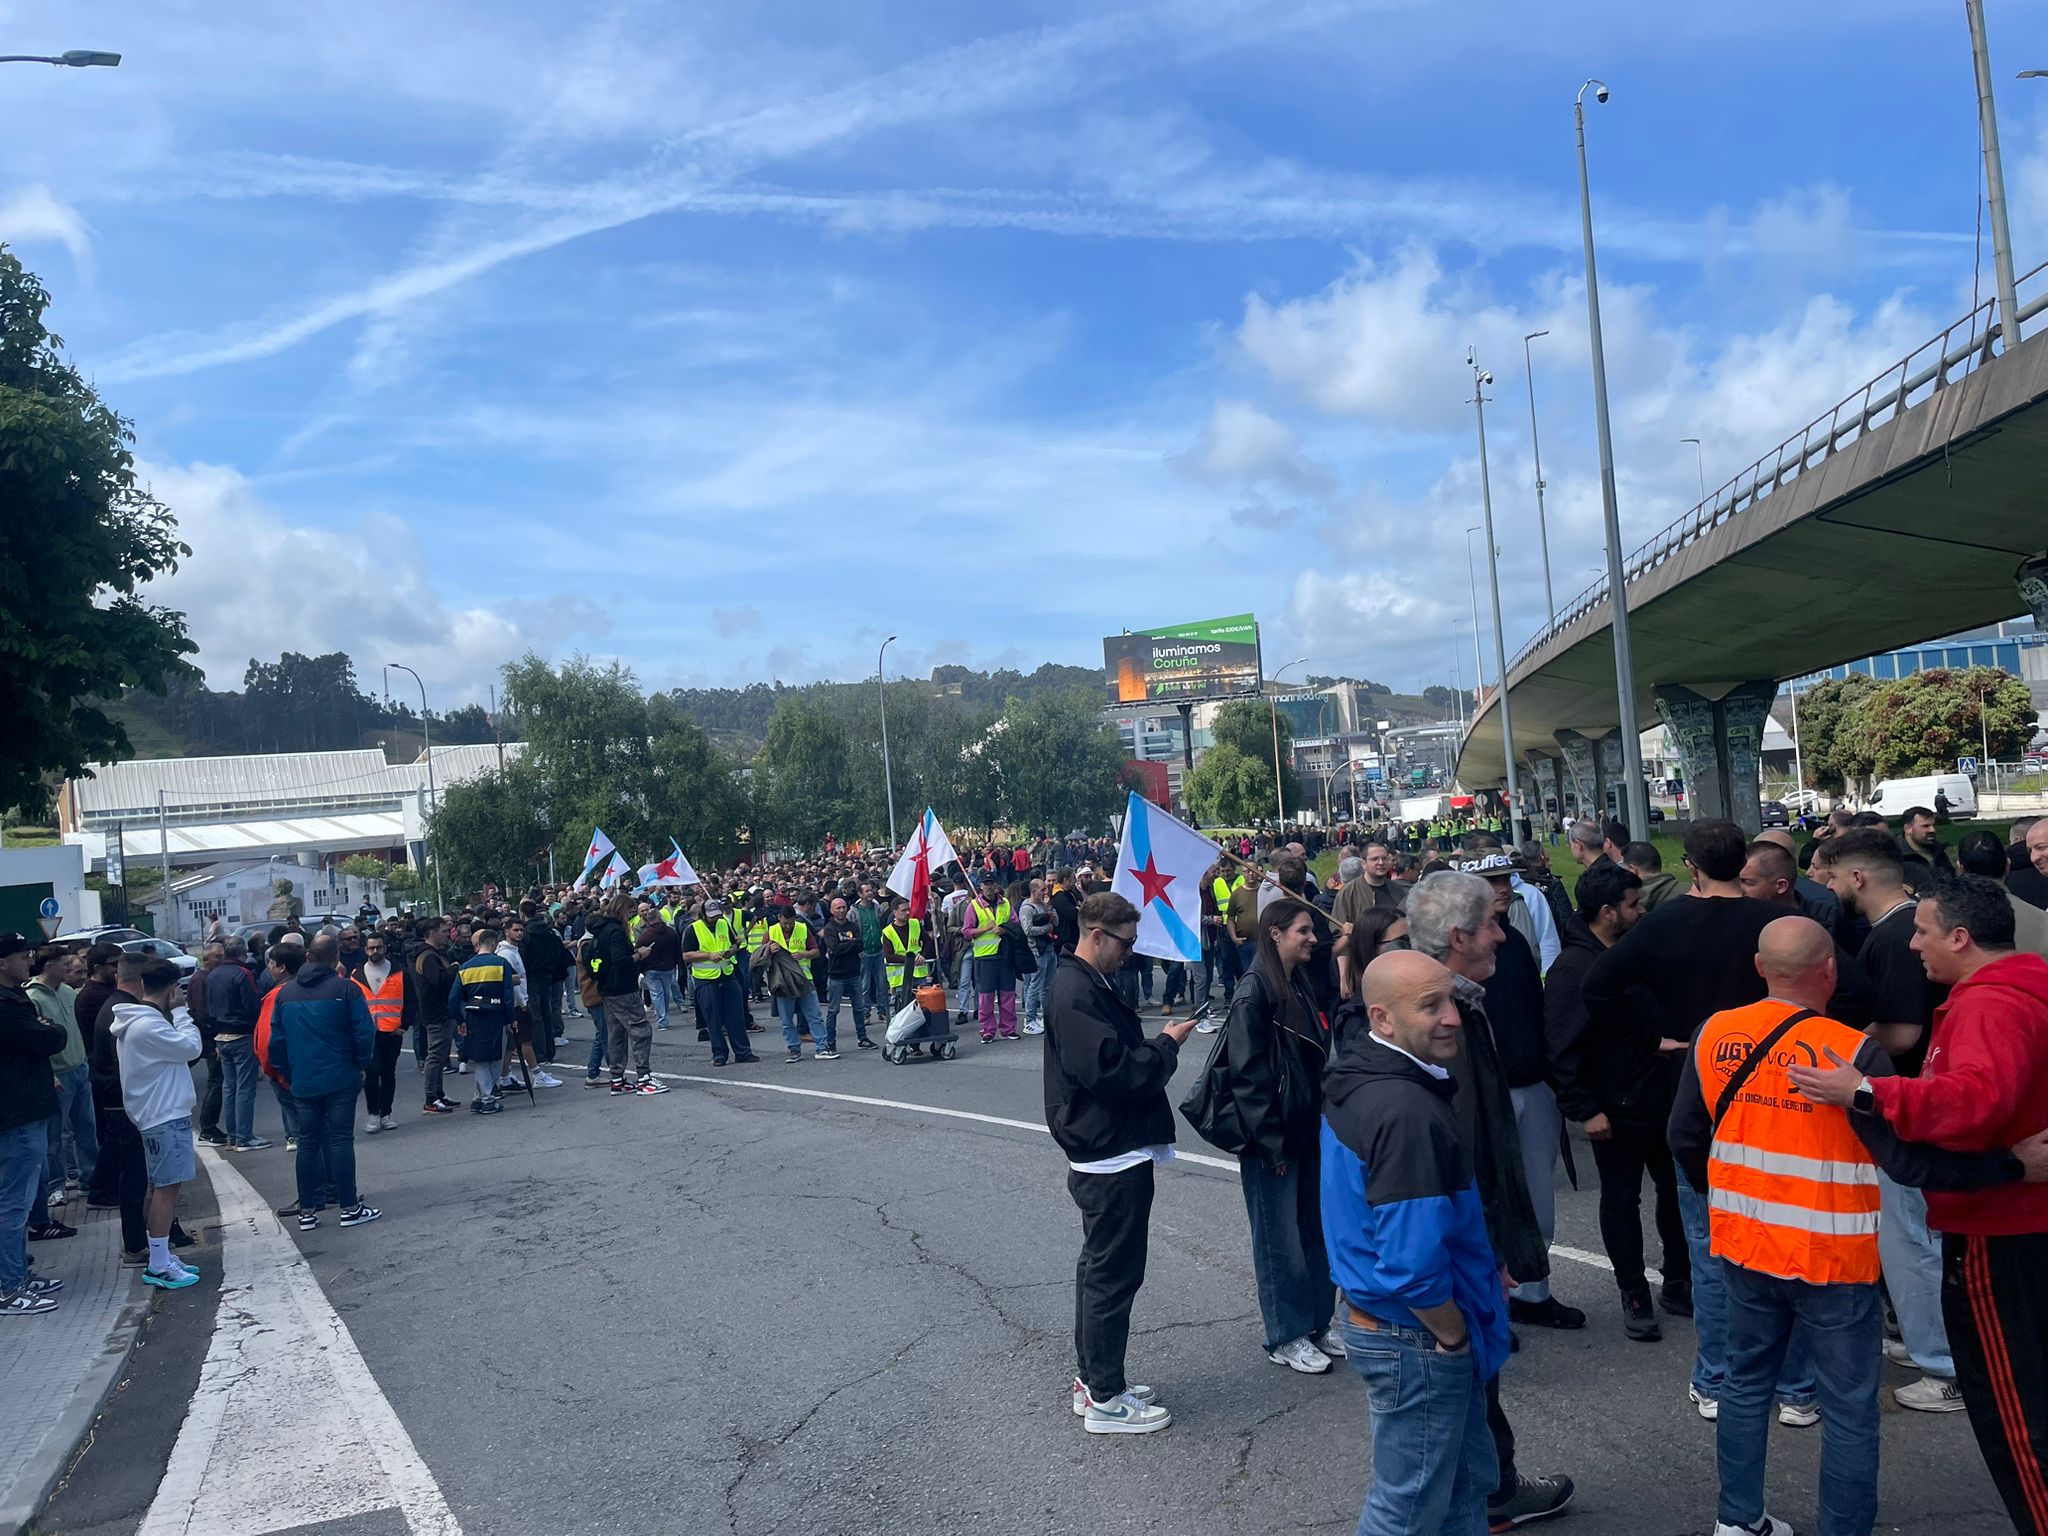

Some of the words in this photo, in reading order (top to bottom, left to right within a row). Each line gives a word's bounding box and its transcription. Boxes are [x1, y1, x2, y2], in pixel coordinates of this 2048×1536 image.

[1152, 643, 1221, 659] iluminamos
[1153, 655, 1198, 669] Coruña
[1716, 1042, 1753, 1062] UGT
